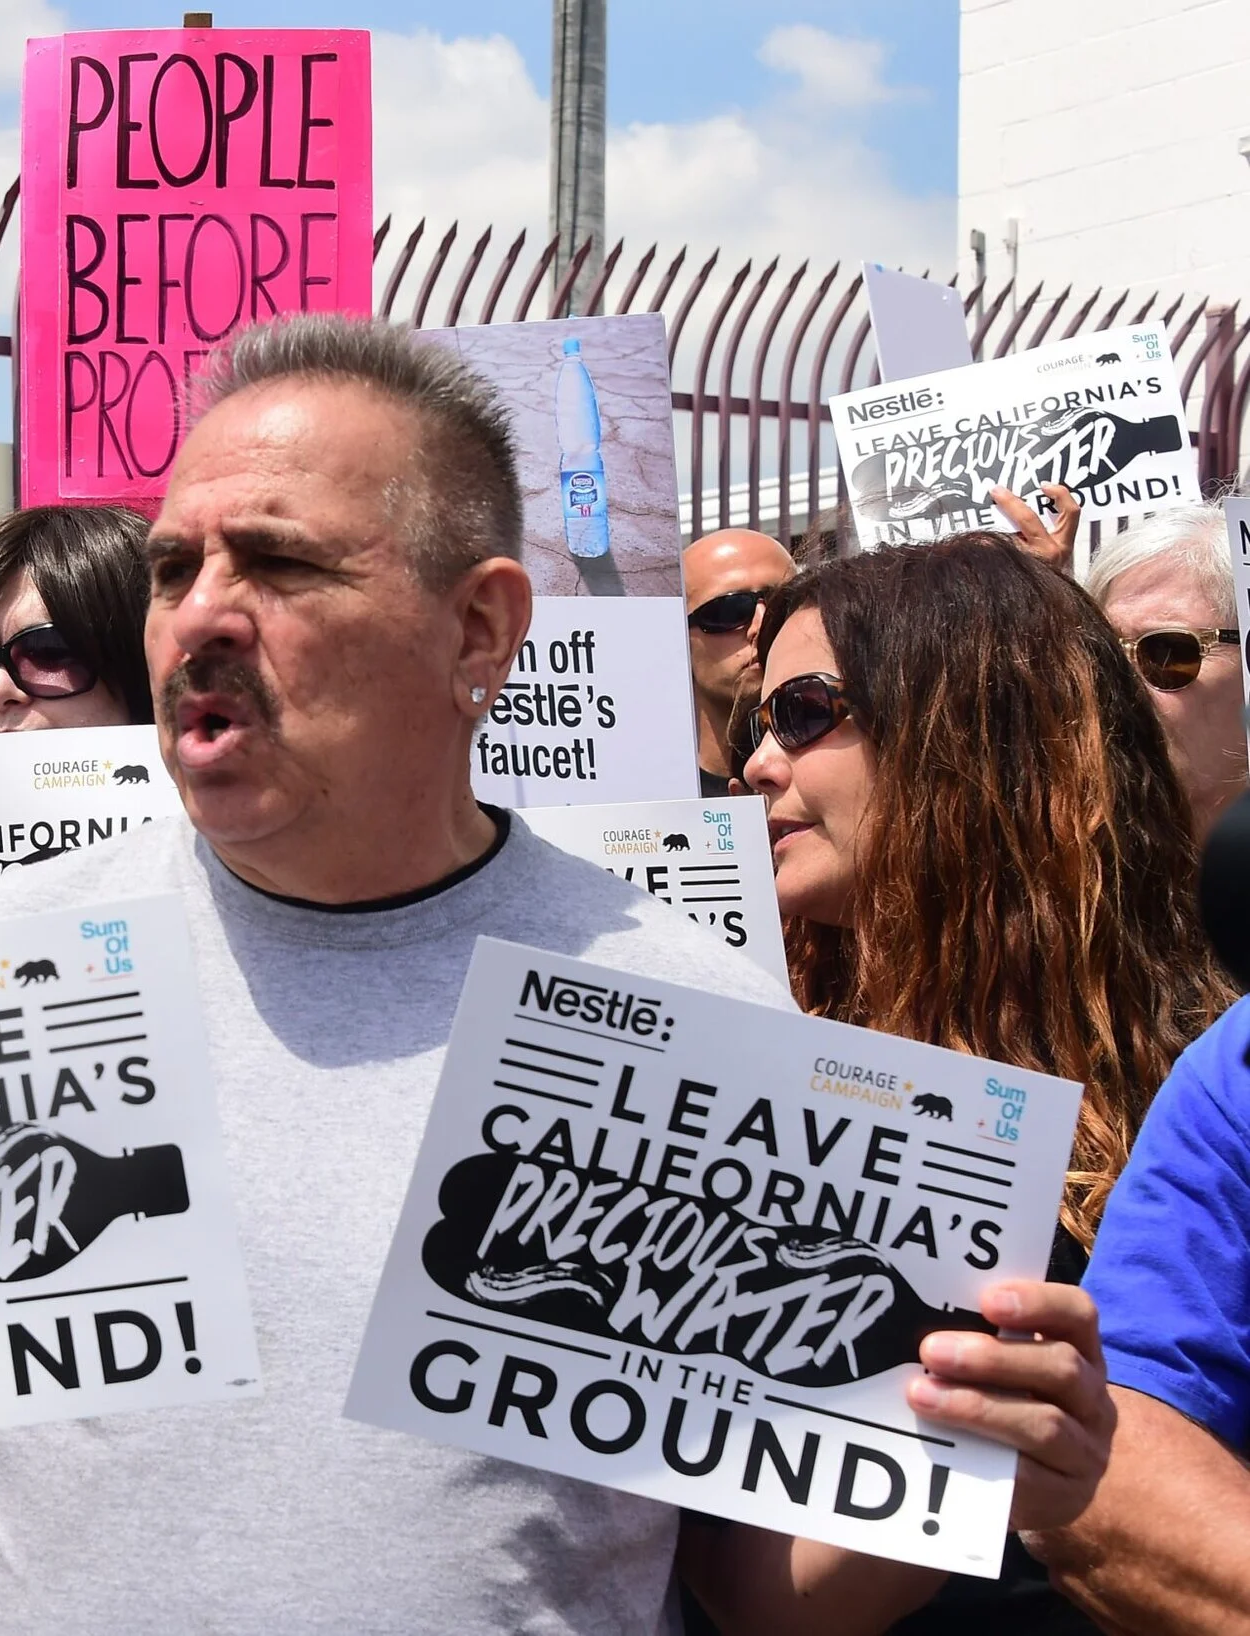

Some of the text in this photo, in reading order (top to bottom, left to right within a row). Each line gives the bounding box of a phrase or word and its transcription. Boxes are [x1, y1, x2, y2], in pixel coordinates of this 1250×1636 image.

[67, 53, 337, 190] PEOPLE
[66, 212, 337, 345] BEFORE
[1132, 334, 1158, 343] Sum
[1146, 341, 1159, 350] Of
[1037, 354, 1084, 373] COURAGE
[1146, 350, 1161, 359] Us
[855, 377, 1162, 457] LEAVE CALIFORNIA'S
[885, 424, 1039, 502] PRECIOUS
[970, 417, 1117, 504] WATER
[1023, 475, 1182, 515] ROUND!
[549, 631, 595, 674] off
[33, 760, 99, 775] COURAGE
[477, 733, 596, 780] faucet!
[34, 773, 106, 790] CAMPAIGN
[703, 811, 731, 823] Sum
[603, 829, 651, 842] COURAGE
[717, 824, 732, 837] Of
[604, 842, 658, 855] CAMPAIGN
[718, 839, 734, 851] Us
[80, 919, 128, 939] Sum
[105, 936, 129, 954] Of
[105, 956, 133, 974] Us
[814, 1057, 898, 1091] COURAGE
[810, 1075, 903, 1111] CAMPAIGN
[985, 1077, 1027, 1103] Sum
[1001, 1102, 1023, 1121] Of
[610, 1065, 909, 1186] LEAVE
[995, 1121, 1020, 1141] Us
[481, 1104, 1002, 1271] CALIFORNIA'S
[478, 1161, 778, 1279] PRECIOUS
[607, 1270, 896, 1381] WATER
[620, 1350, 754, 1406] IN THE
[408, 1338, 952, 1537] GROUND!
